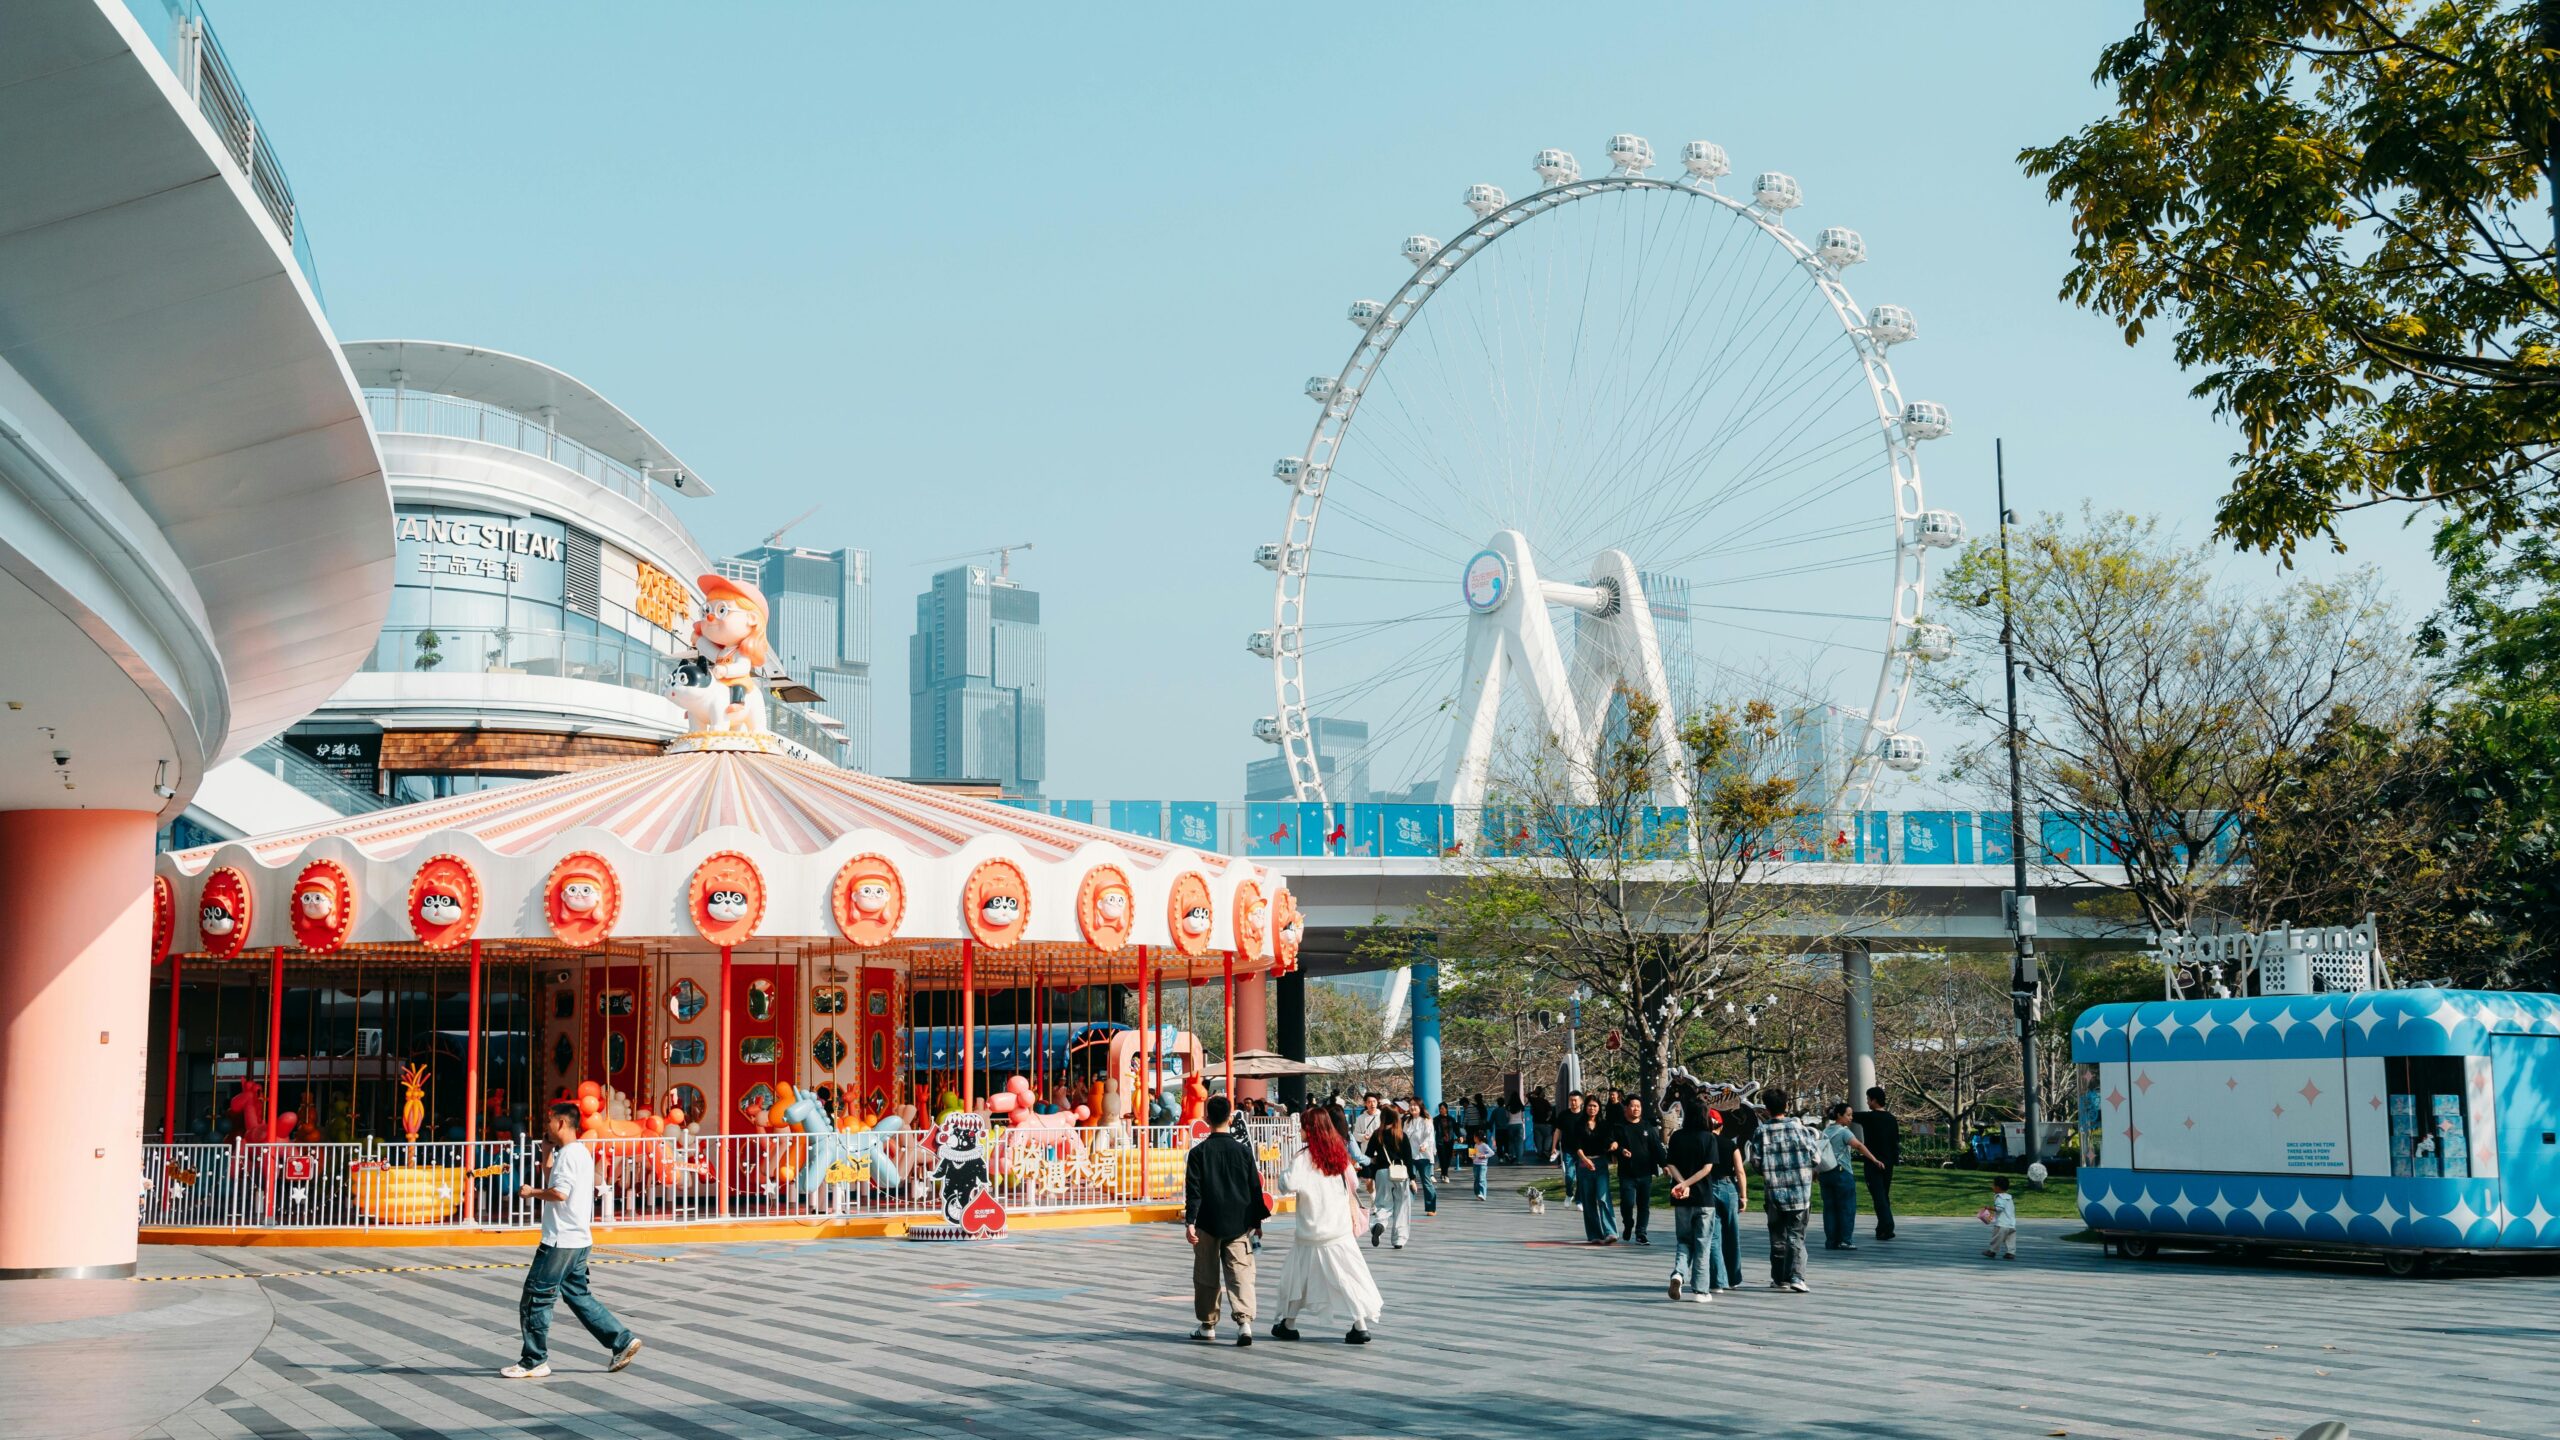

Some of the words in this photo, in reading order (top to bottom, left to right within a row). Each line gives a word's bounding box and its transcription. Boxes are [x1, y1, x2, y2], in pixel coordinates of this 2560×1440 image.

[479, 523, 560, 562] STEAK
[418, 551, 524, 582] 王品牛排
[2158, 929, 2267, 969] Starry
[2281, 911, 2377, 956] Land
